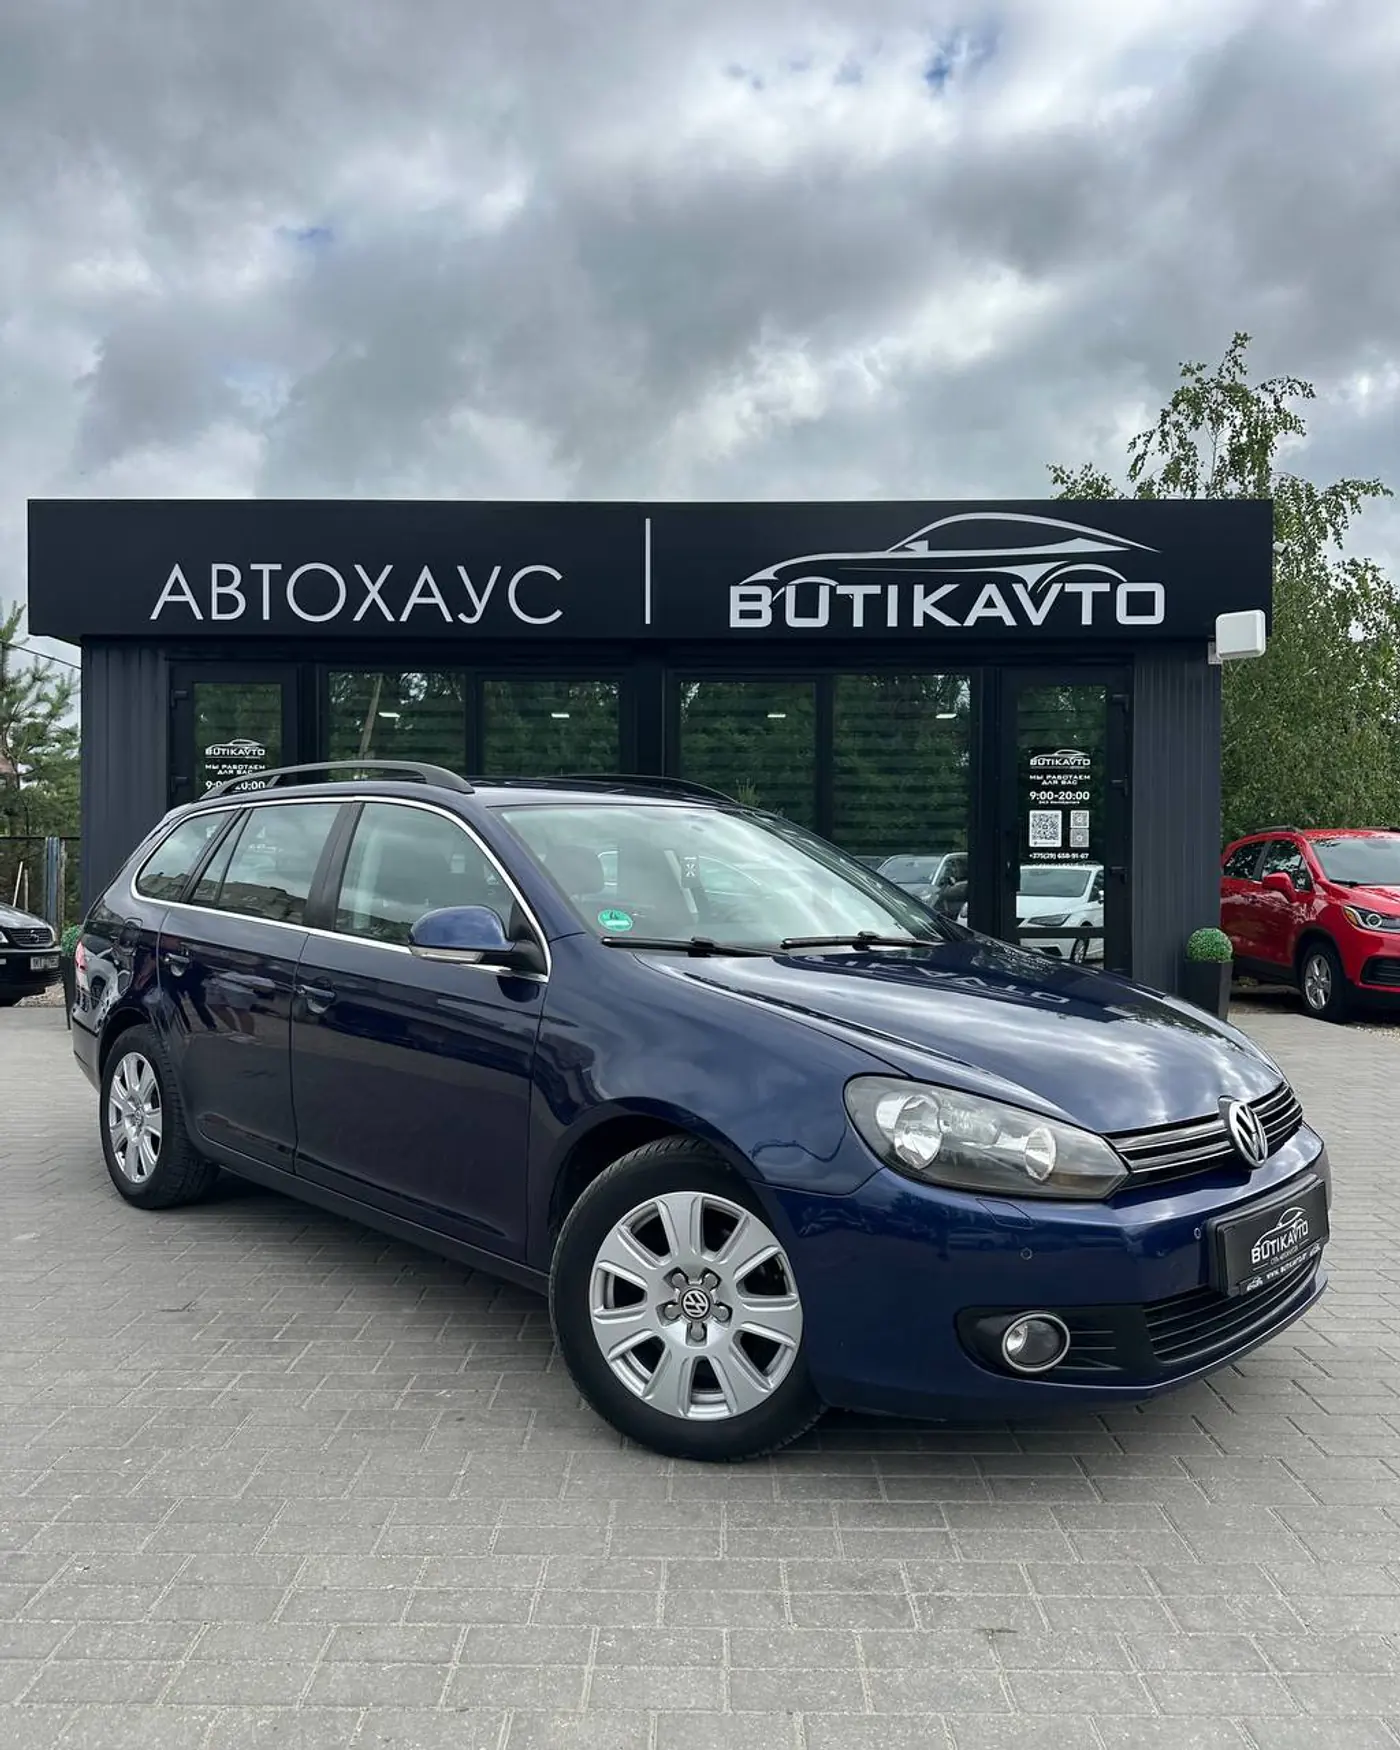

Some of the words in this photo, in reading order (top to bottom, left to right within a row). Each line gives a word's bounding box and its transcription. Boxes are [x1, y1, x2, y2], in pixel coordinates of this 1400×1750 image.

[150, 562, 563, 625] АВТОХАУС
[729, 582, 1166, 628] BUTIKAVTO
[1029, 758, 1091, 766] BUTIKAVTO
[1029, 791, 1090, 800] 9:00-20:00
[1251, 1219, 1309, 1265] BUTIKAVTO
